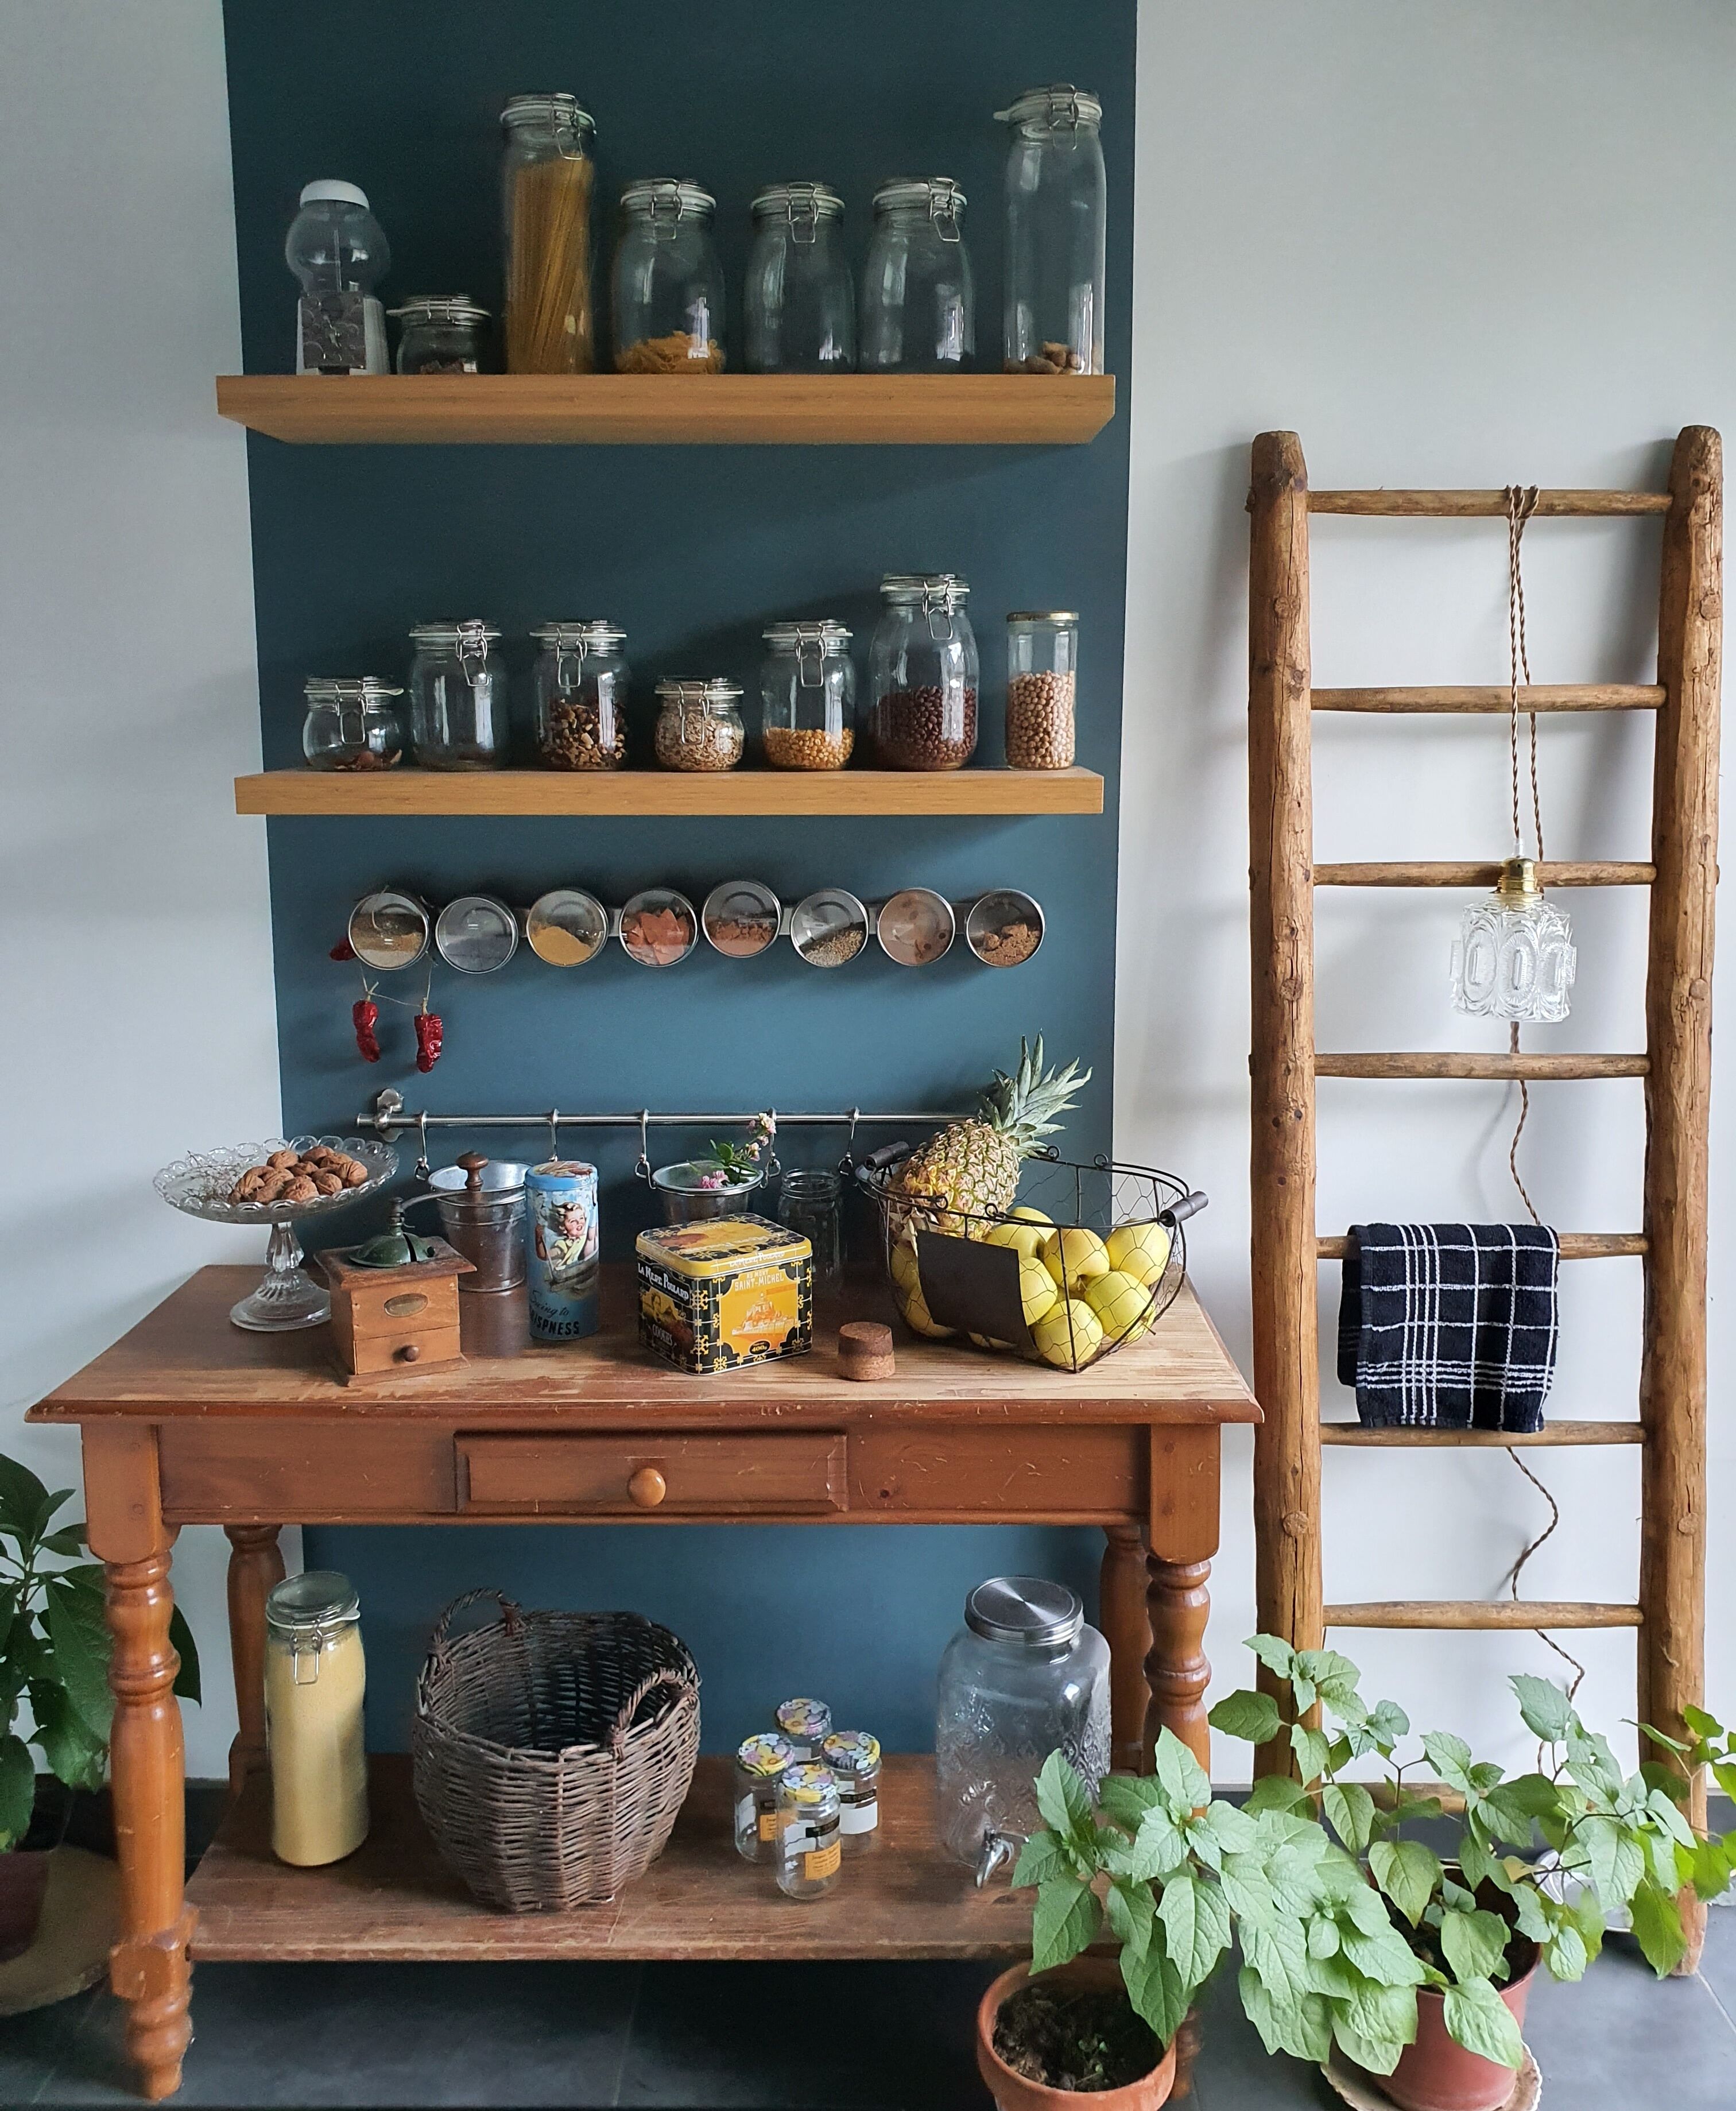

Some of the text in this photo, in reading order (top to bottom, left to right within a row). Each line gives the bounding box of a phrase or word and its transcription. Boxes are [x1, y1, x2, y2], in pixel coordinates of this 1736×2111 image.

[638, 1263, 645, 1275] LA
[735, 1272, 784, 1291] SAINT-MICHEL
[530, 1289, 569, 1318] Swing to
